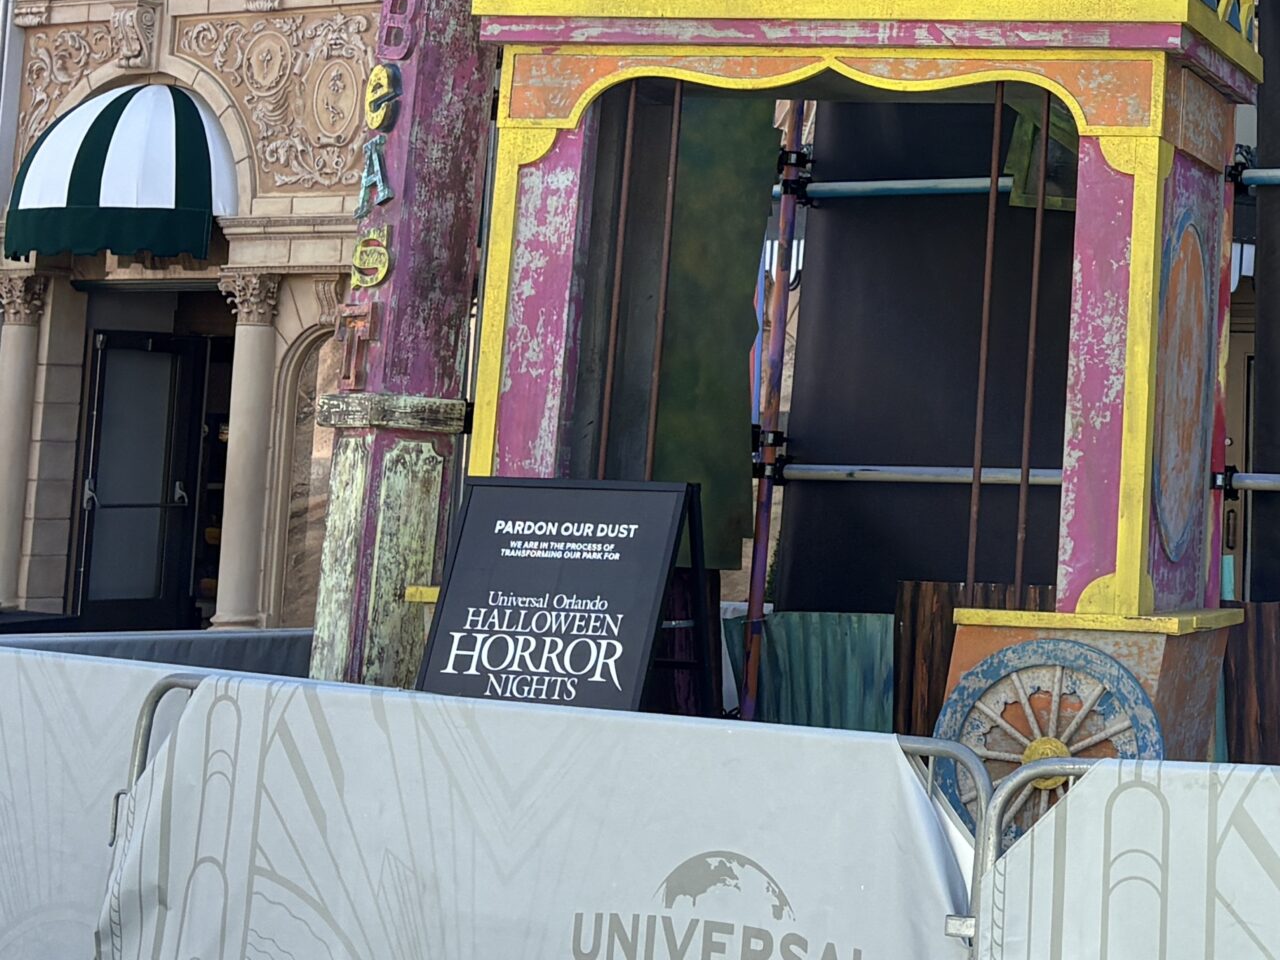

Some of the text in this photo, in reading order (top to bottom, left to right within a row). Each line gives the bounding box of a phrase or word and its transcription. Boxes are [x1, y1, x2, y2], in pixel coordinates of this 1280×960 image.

[494, 520, 639, 538] PARDON OUR DUST
[501, 548, 620, 560] TRANSFORMING OUR PARK FOR
[510, 540, 615, 552] WE ARE IN THE PROCESS OF
[488, 591, 608, 611] Universal Orlando
[463, 607, 623, 637] HALLOWEEN
[440, 632, 623, 691] HORROR
[484, 673, 578, 701] NIGHTS
[572, 912, 863, 960] UNIVERS
